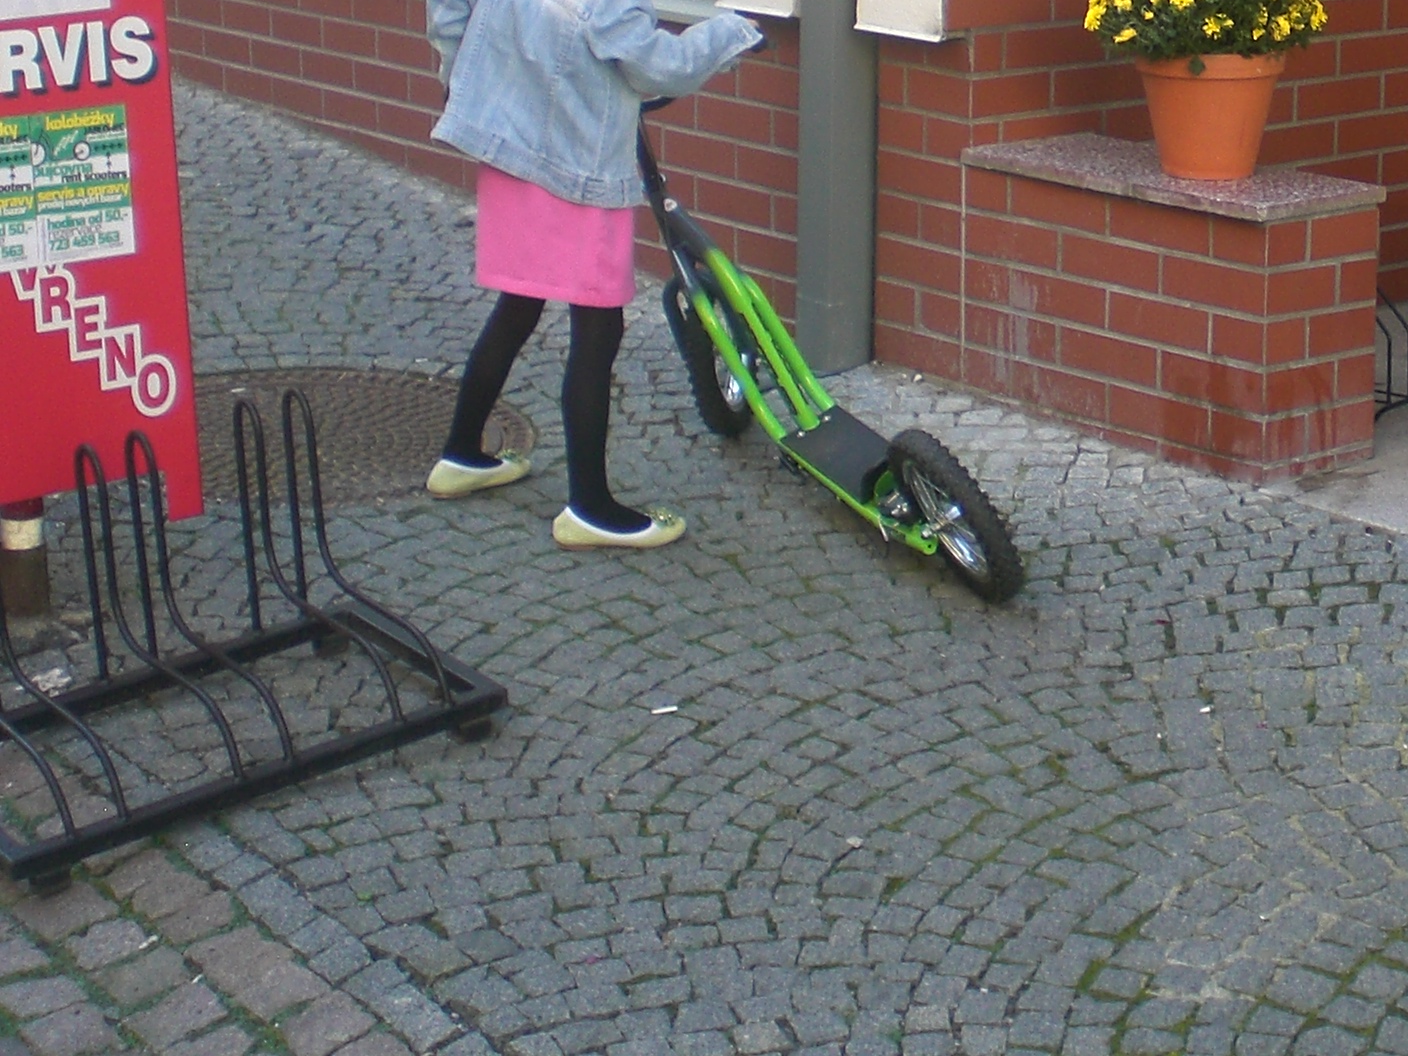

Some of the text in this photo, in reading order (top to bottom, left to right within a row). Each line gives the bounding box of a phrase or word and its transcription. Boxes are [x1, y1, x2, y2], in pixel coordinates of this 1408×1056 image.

[0, 16, 152, 93] RVIS
[62, 170, 127, 183] rent scooters
[38, 187, 74, 201] servis
[87, 183, 129, 198] opravy
[48, 216, 85, 230] hodina
[88, 213, 102, 224] od
